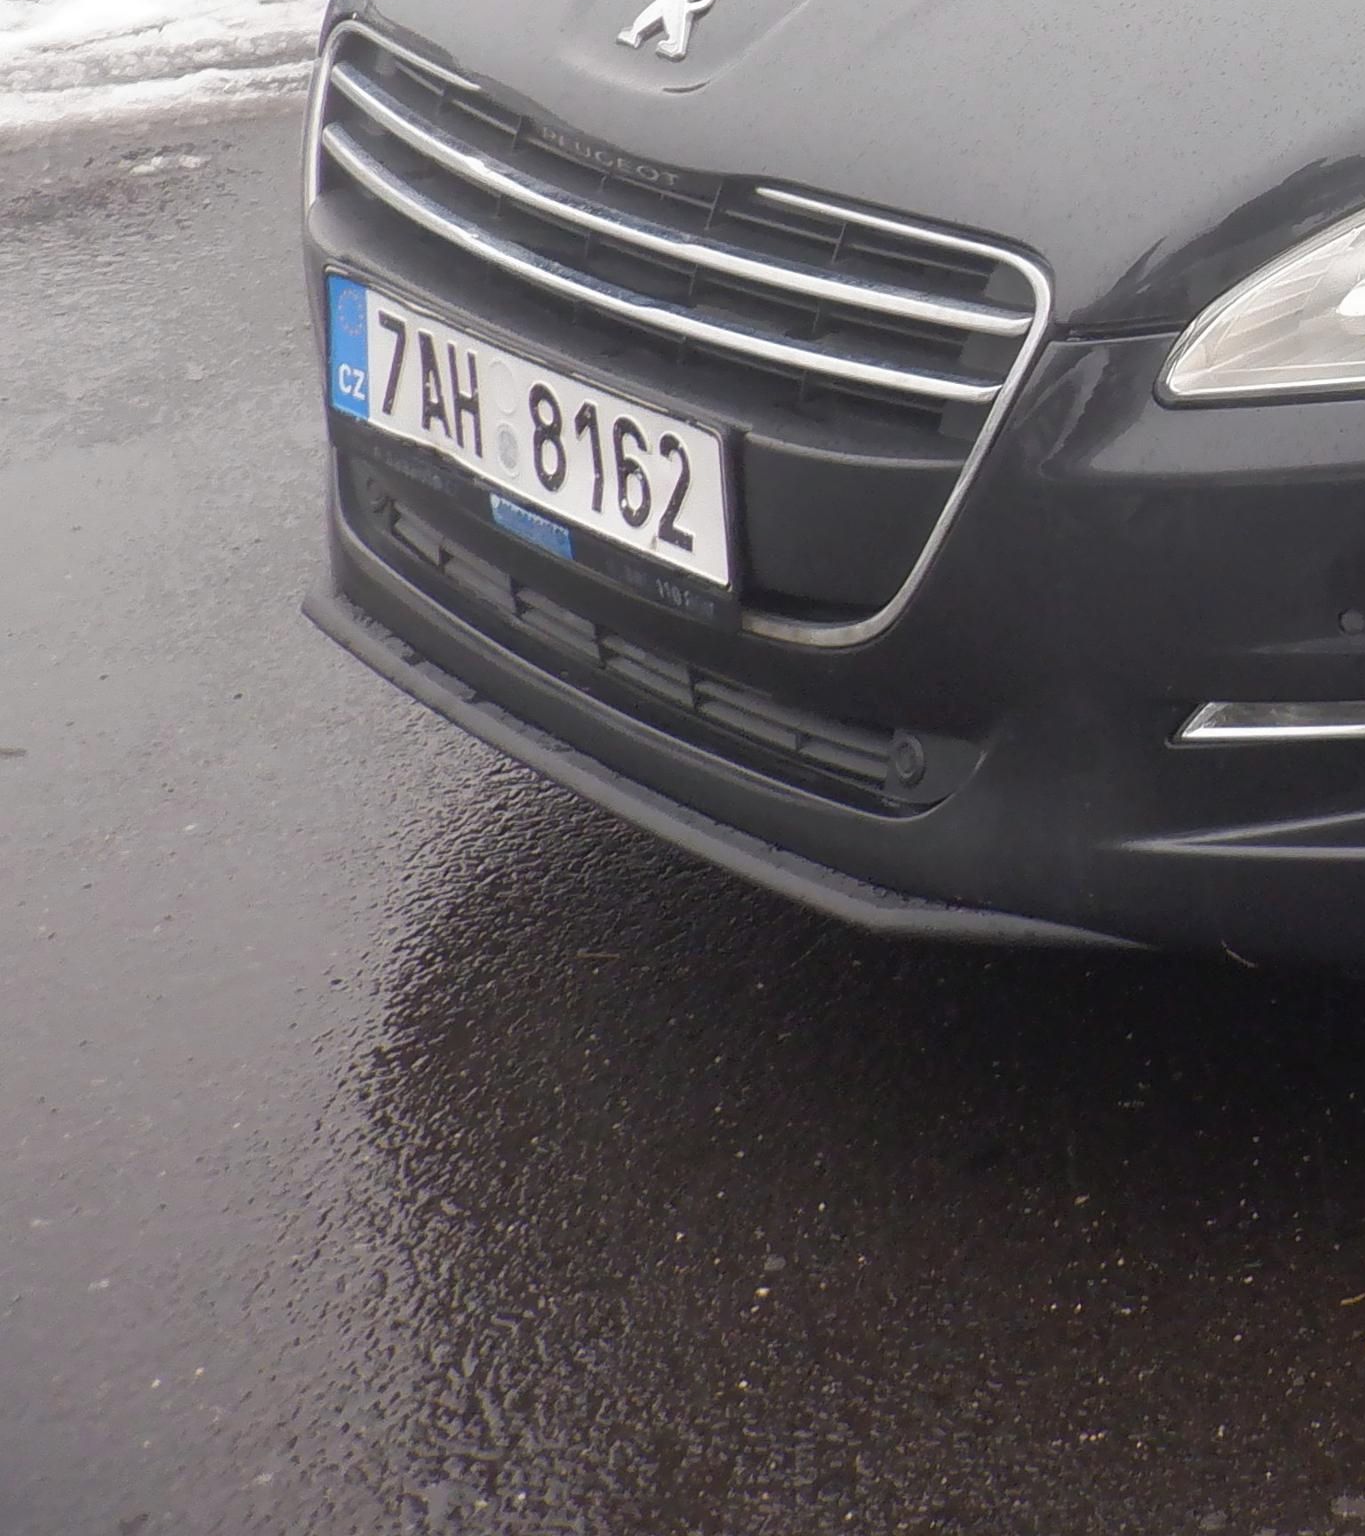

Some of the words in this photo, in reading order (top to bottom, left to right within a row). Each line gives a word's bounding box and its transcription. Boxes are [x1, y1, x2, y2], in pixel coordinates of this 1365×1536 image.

[338, 363, 366, 401] CZ
[378, 308, 483, 459] 7AH
[528, 379, 695, 554] 8162
